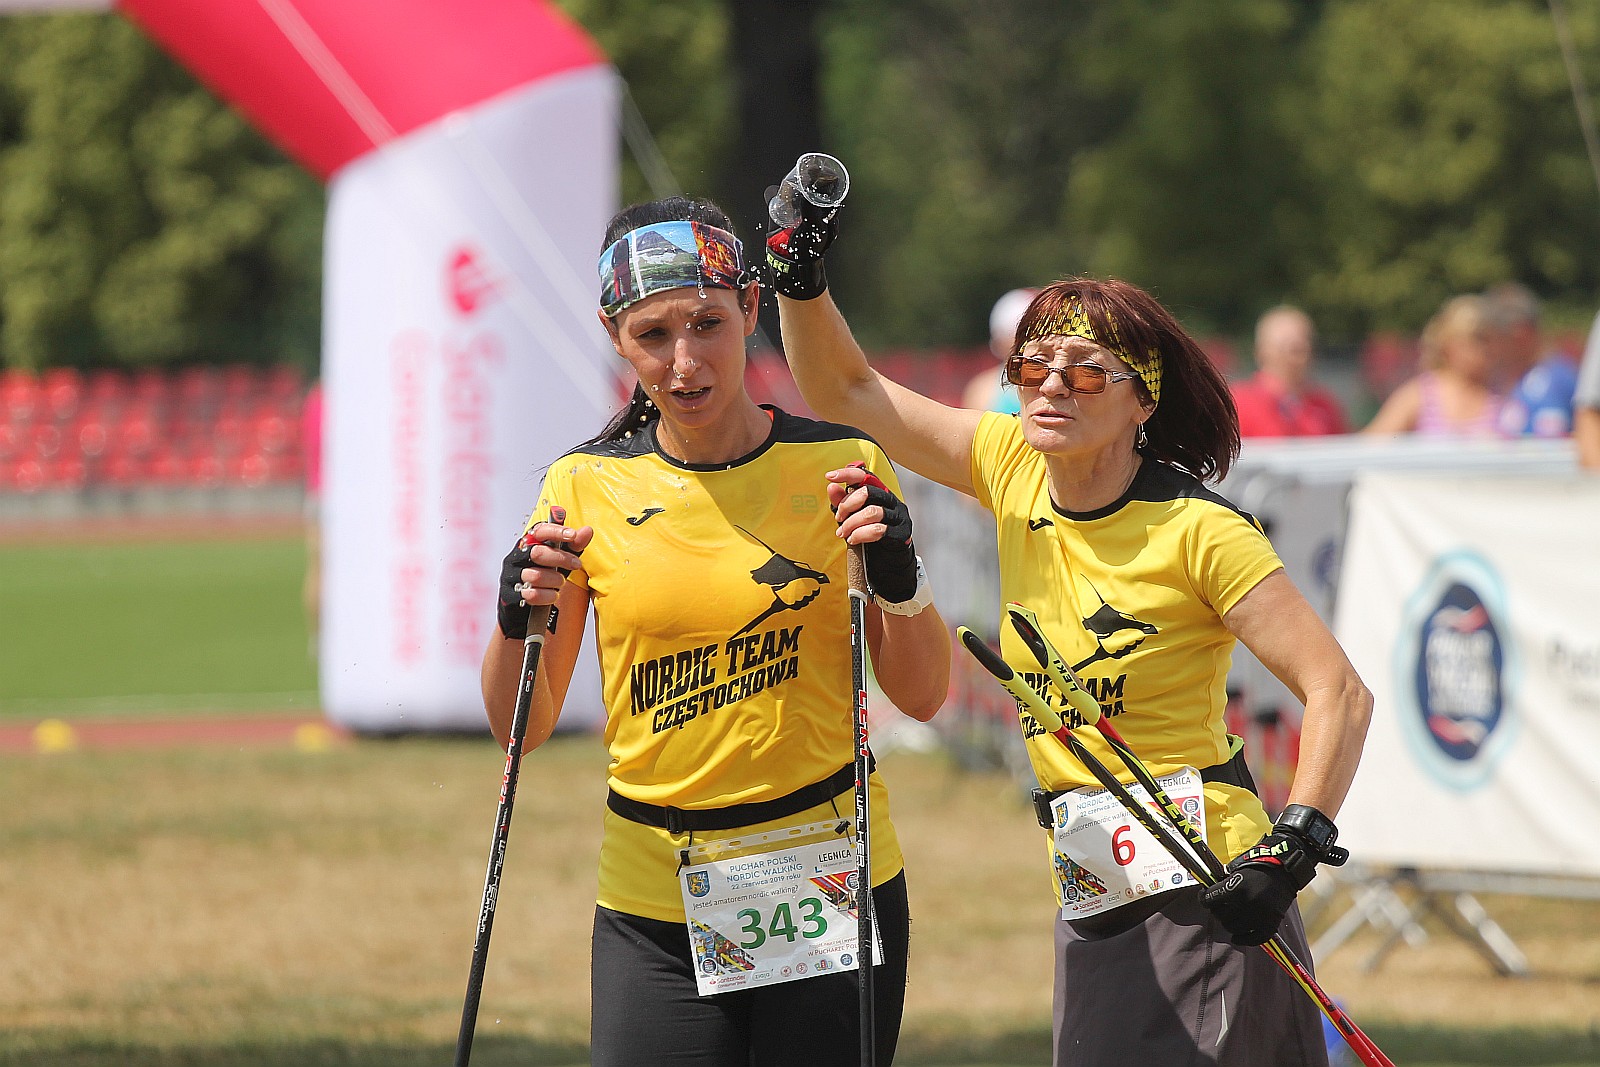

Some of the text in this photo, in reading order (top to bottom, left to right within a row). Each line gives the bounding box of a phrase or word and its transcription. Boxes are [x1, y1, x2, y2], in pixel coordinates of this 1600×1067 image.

[630, 625, 804, 716] NORDIC TEAM
[1054, 659, 1079, 692] LEKI
[652, 656, 799, 734] CZĘSTOCHOWA
[1158, 776, 1191, 788] LEGNICA
[1076, 796, 1104, 811] NORDIC
[1088, 804, 1111, 815] czerwca
[1155, 791, 1202, 844] LEKI
[856, 795, 865, 869] WALKER
[818, 849, 852, 863] LEGNICA
[1111, 825, 1136, 867] 6
[1249, 841, 1289, 859] LEKI
[726, 863, 803, 883] NORDIC WALKING
[730, 855, 797, 873] PUCHAR POLSKI
[490, 840, 506, 912] WALKER
[741, 880, 769, 888] czerwca
[770, 876, 785, 884] 2019
[786, 872, 801, 881] roku
[714, 894, 747, 906] amatorem
[749, 890, 769, 900] nordic
[771, 885, 799, 896] walking?
[737, 897, 828, 950] 343
[717, 974, 746, 984] Santander
